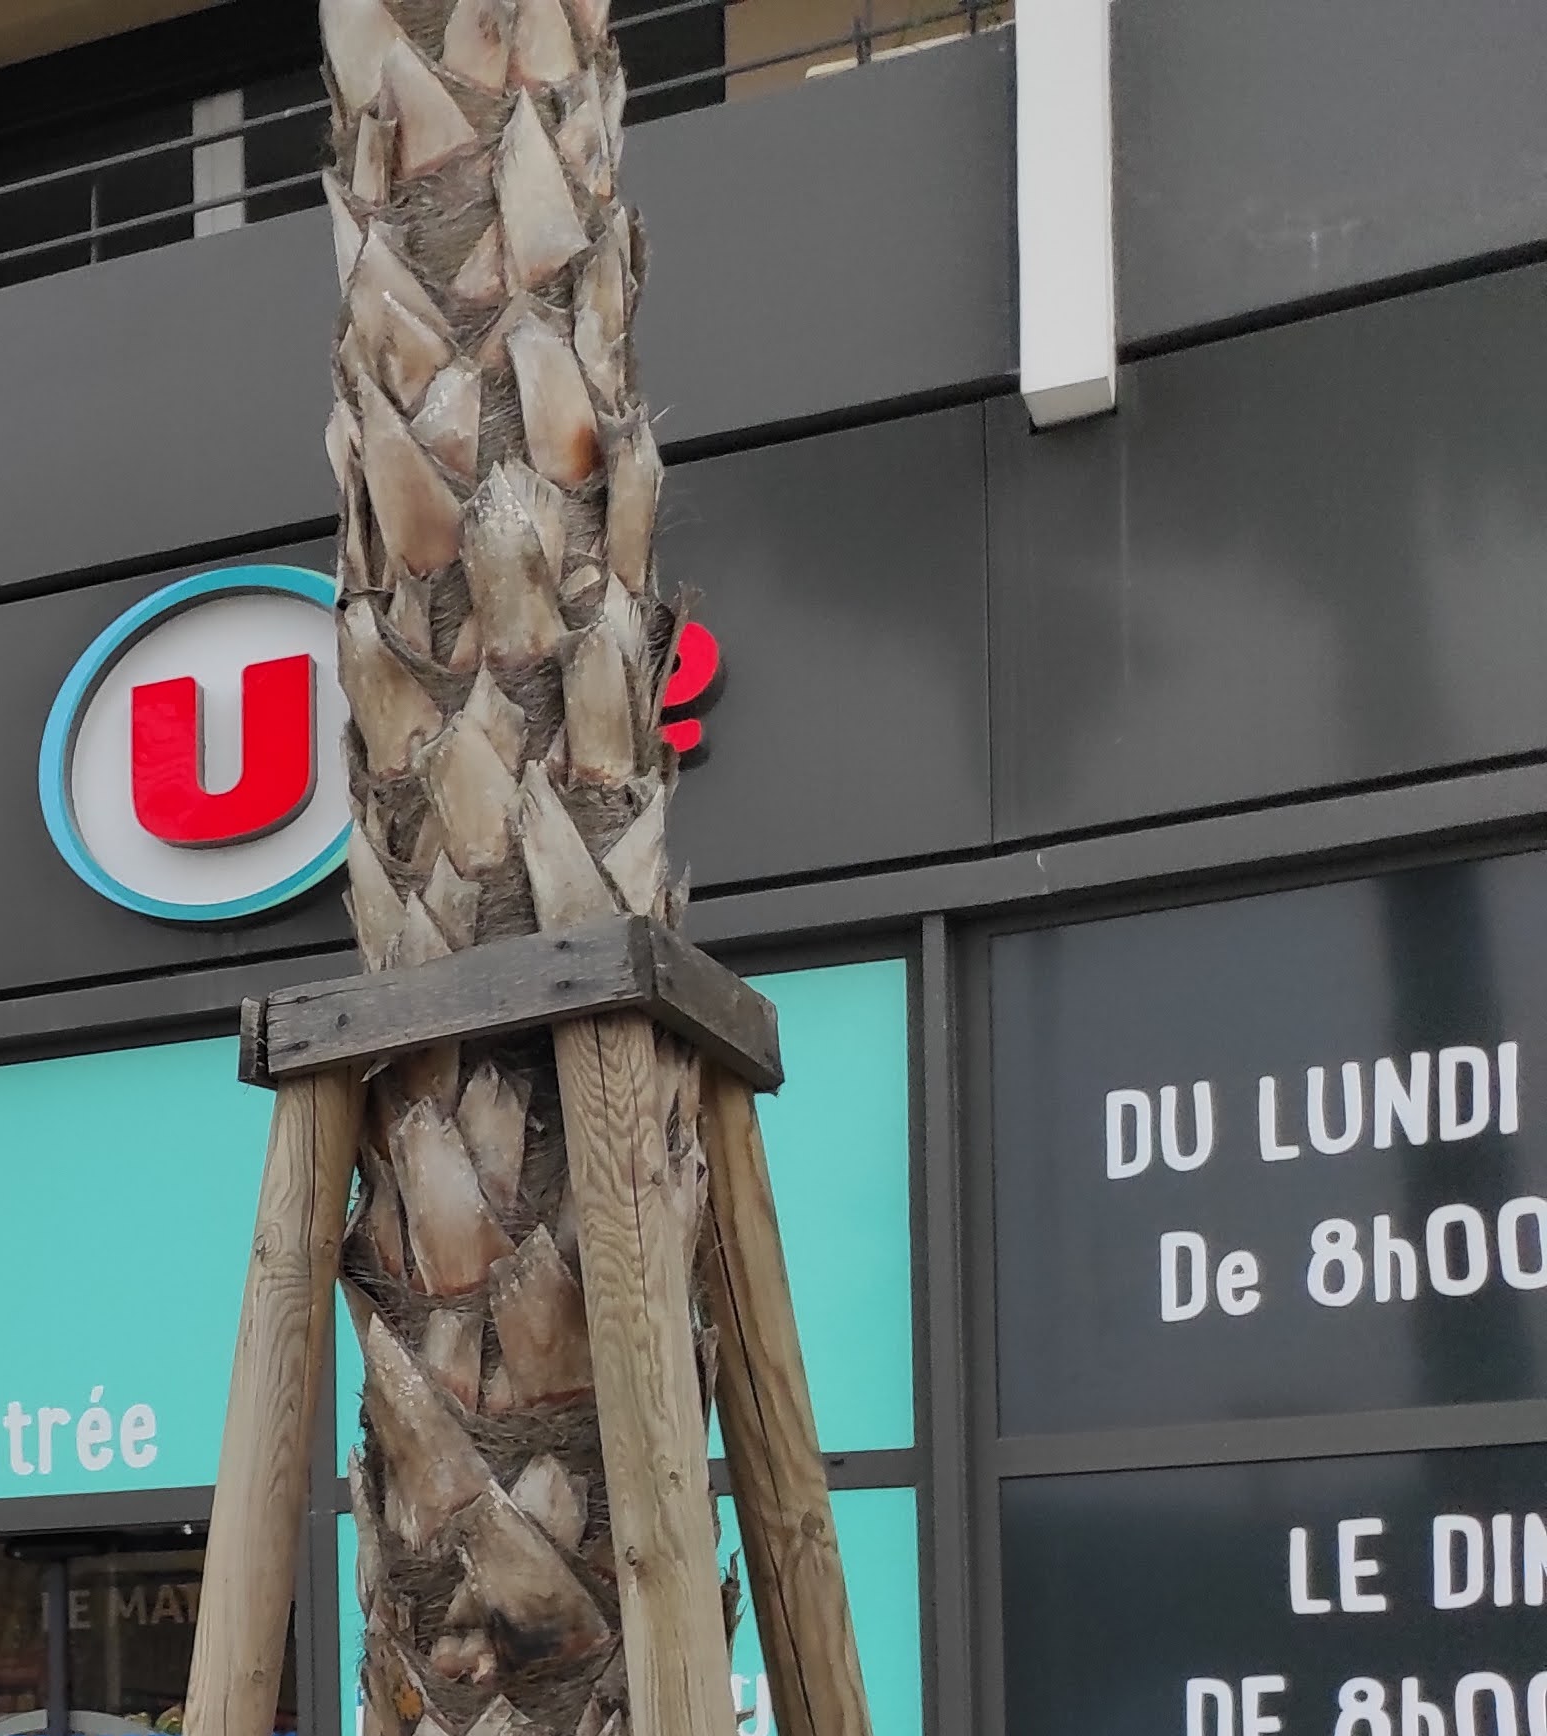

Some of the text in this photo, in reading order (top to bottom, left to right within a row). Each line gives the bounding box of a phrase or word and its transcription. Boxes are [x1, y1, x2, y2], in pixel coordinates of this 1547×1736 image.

[1106, 1041, 1519, 1180] DU LUNDI
[1160, 1195, 1547, 1323] De 8h00
[1289, 1517, 1388, 1615] LE
